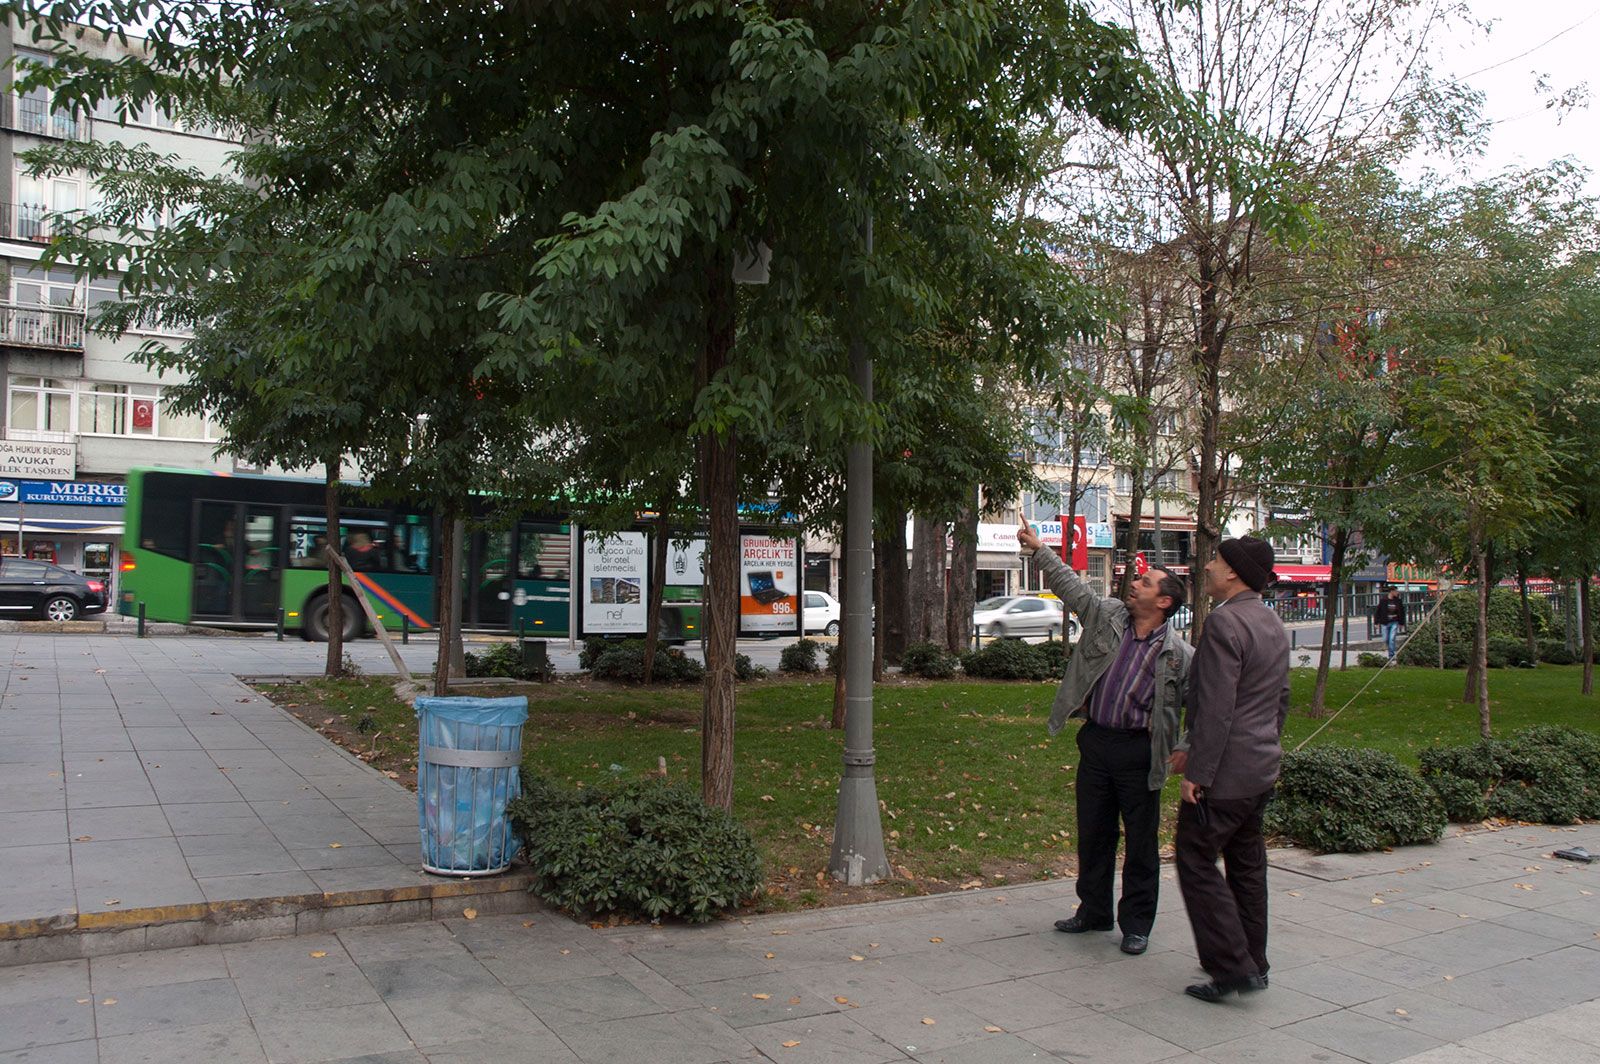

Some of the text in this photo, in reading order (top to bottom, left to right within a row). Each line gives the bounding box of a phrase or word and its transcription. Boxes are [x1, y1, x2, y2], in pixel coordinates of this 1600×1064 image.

[15, 445, 42, 454] HUKUK
[43, 446, 72, 456] BÜROSU
[8, 456, 55, 465] AVUKAT
[23, 466, 71, 476] TAŞÖREN
[50, 482, 129, 496] MERKE
[26, 493, 93, 503] KURUYEMİŞ
[993, 533, 1016, 541] Canon
[626, 547, 643, 555] ünlü
[601, 556, 630, 564] bir otel
[772, 602, 790, 614] 996
[606, 607, 624, 621] nef
